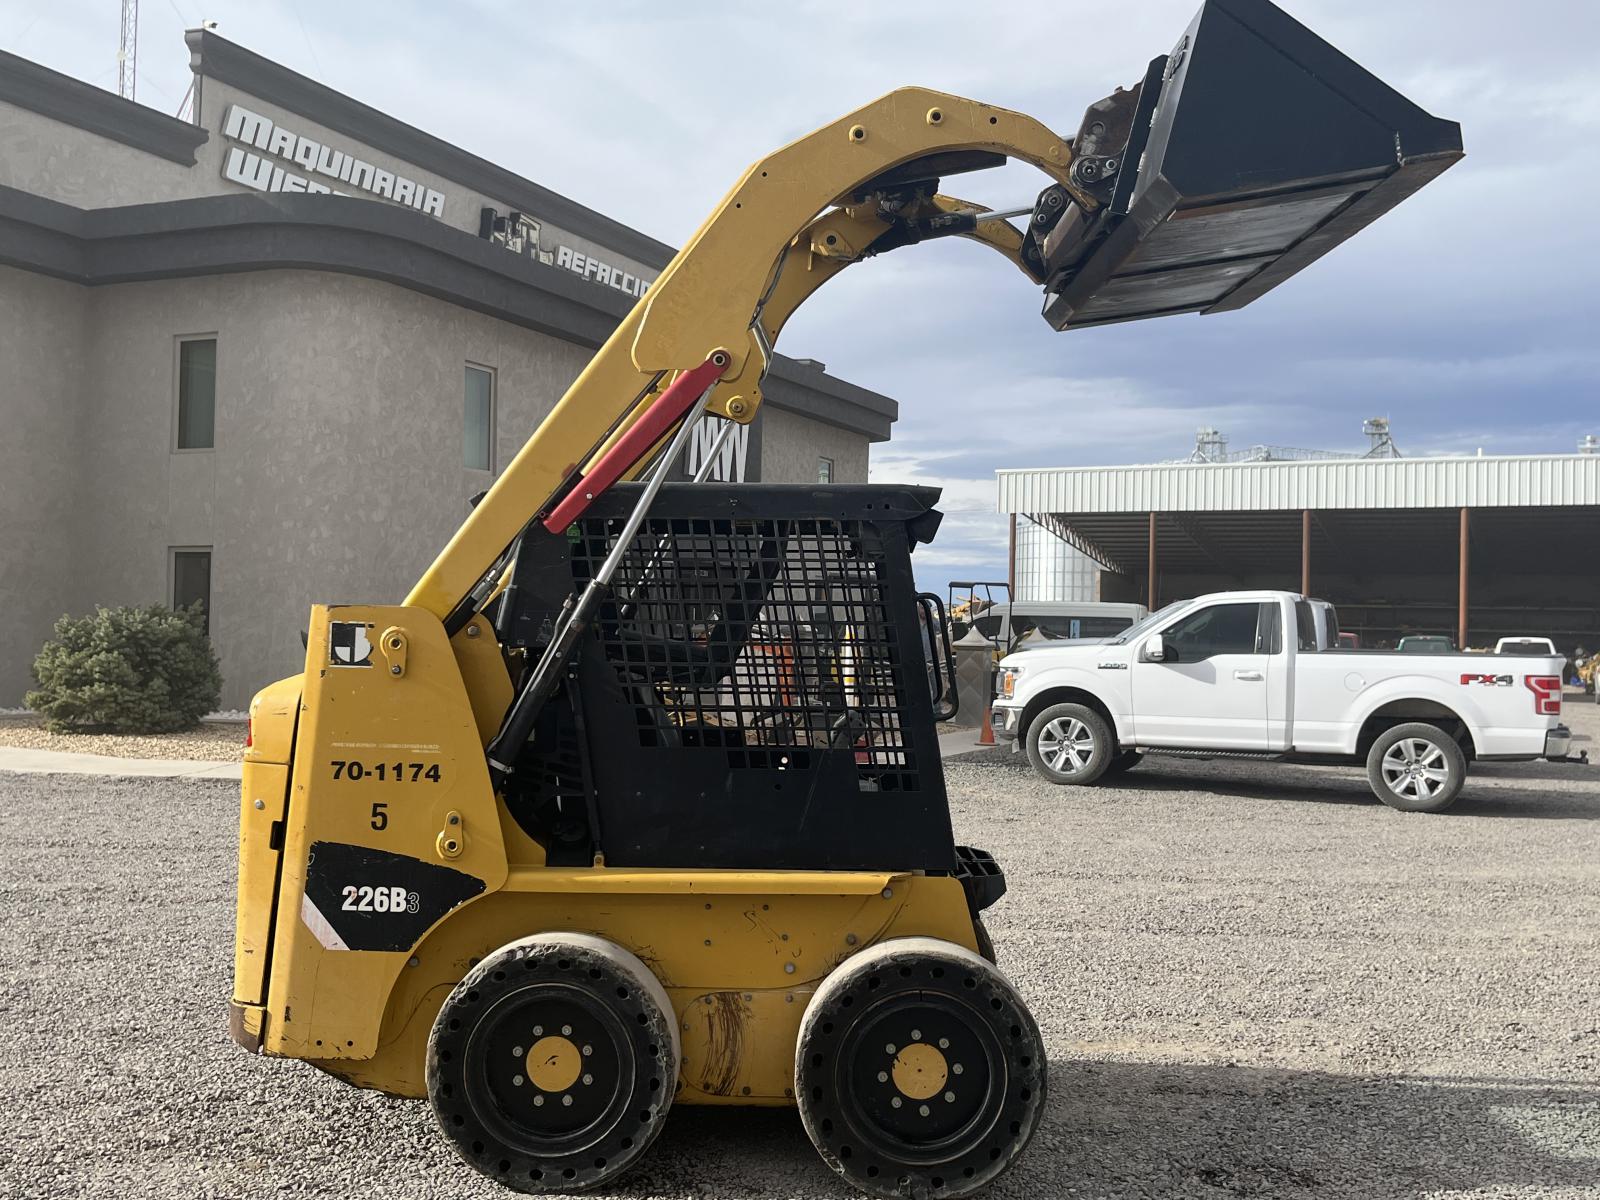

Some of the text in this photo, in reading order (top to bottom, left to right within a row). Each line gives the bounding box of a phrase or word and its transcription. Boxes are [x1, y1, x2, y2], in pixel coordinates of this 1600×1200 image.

[223, 104, 445, 217] MAQUINARIA
[223, 147, 352, 198] WIE
[1460, 674, 1514, 686] FX4
[330, 761, 441, 782] 70-1174
[371, 803, 388, 831] 5
